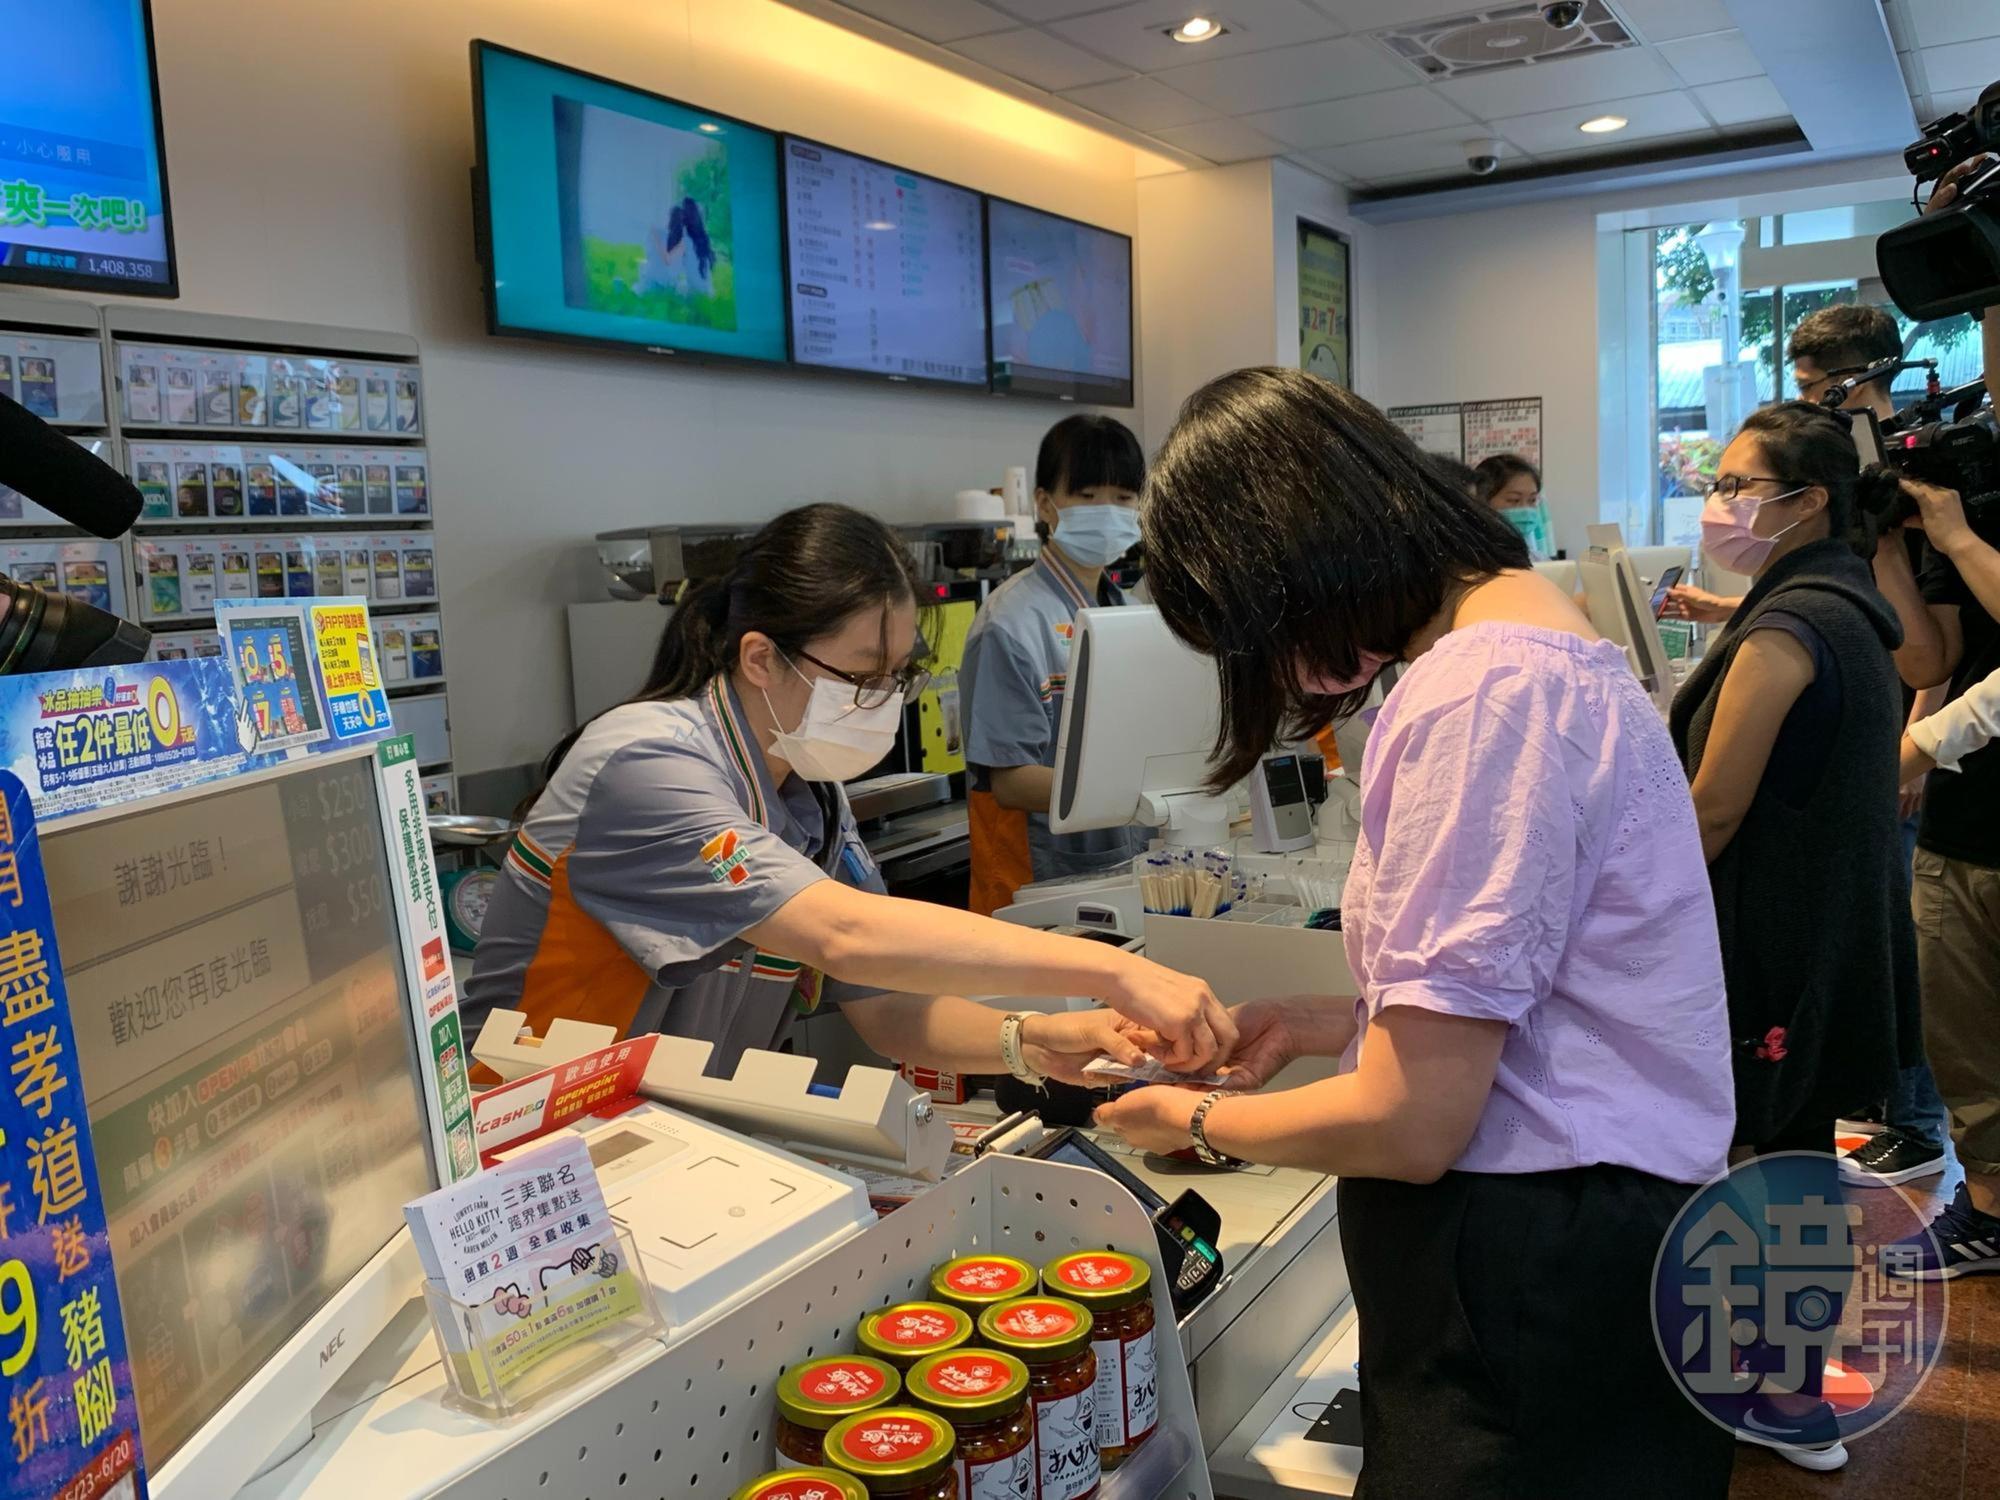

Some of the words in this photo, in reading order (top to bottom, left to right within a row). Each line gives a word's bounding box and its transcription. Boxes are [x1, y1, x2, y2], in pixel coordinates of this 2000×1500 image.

[88, 259, 153, 278] 1,408,358
[113, 836, 228, 907] 謝謝光臨!
[108, 938, 271, 1047] 歡迎您再度光臨
[564, 1046, 632, 1084] 歡迎使用
[501, 1164, 575, 1210] 三美聯名
[450, 1218, 475, 1240] HELLO
[477, 1207, 500, 1226] KITTY
[508, 1188, 583, 1232] 跨界集點送
[529, 1213, 591, 1251] 全套收集
[52, 1214, 89, 1283] 送
[61, 1286, 116, 1448] 豬腳
[319, 1328, 346, 1369] NEC
